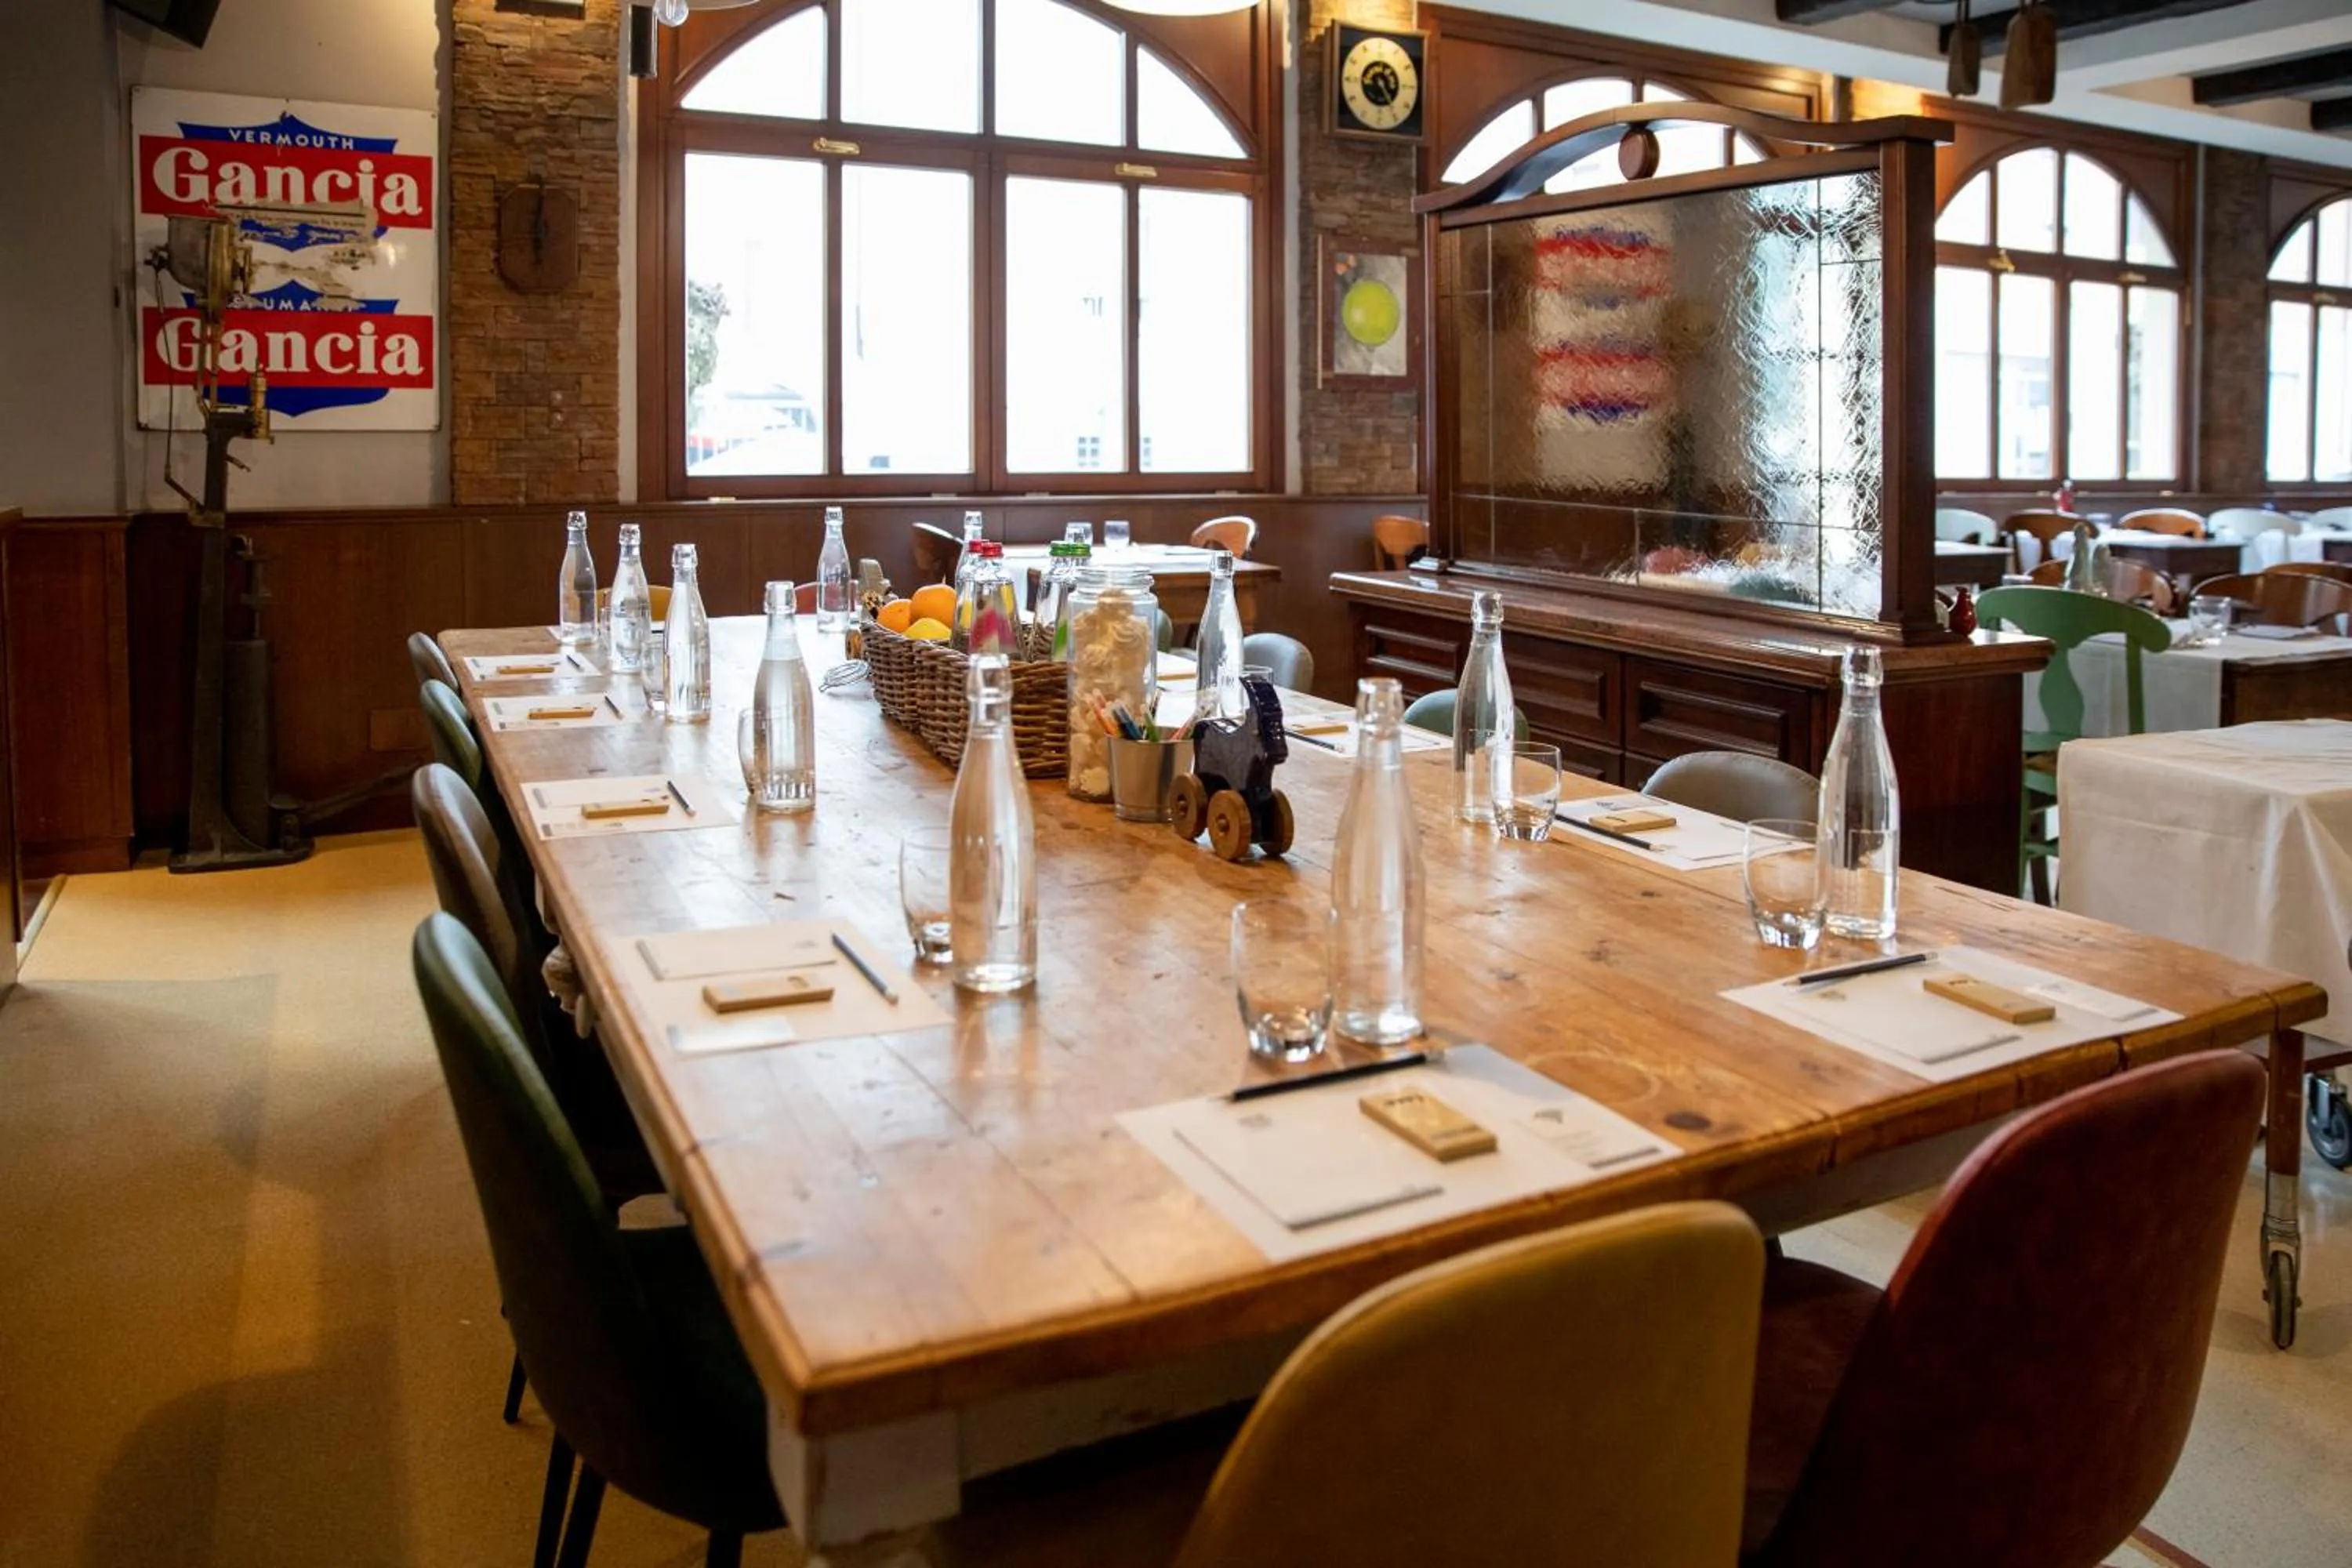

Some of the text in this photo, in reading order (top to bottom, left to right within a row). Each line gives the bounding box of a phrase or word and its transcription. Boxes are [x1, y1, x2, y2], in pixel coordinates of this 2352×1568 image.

[228, 128, 354, 151] VERMOUTH
[153, 147, 423, 216] Gancia
[156, 317, 425, 376] Gancia
